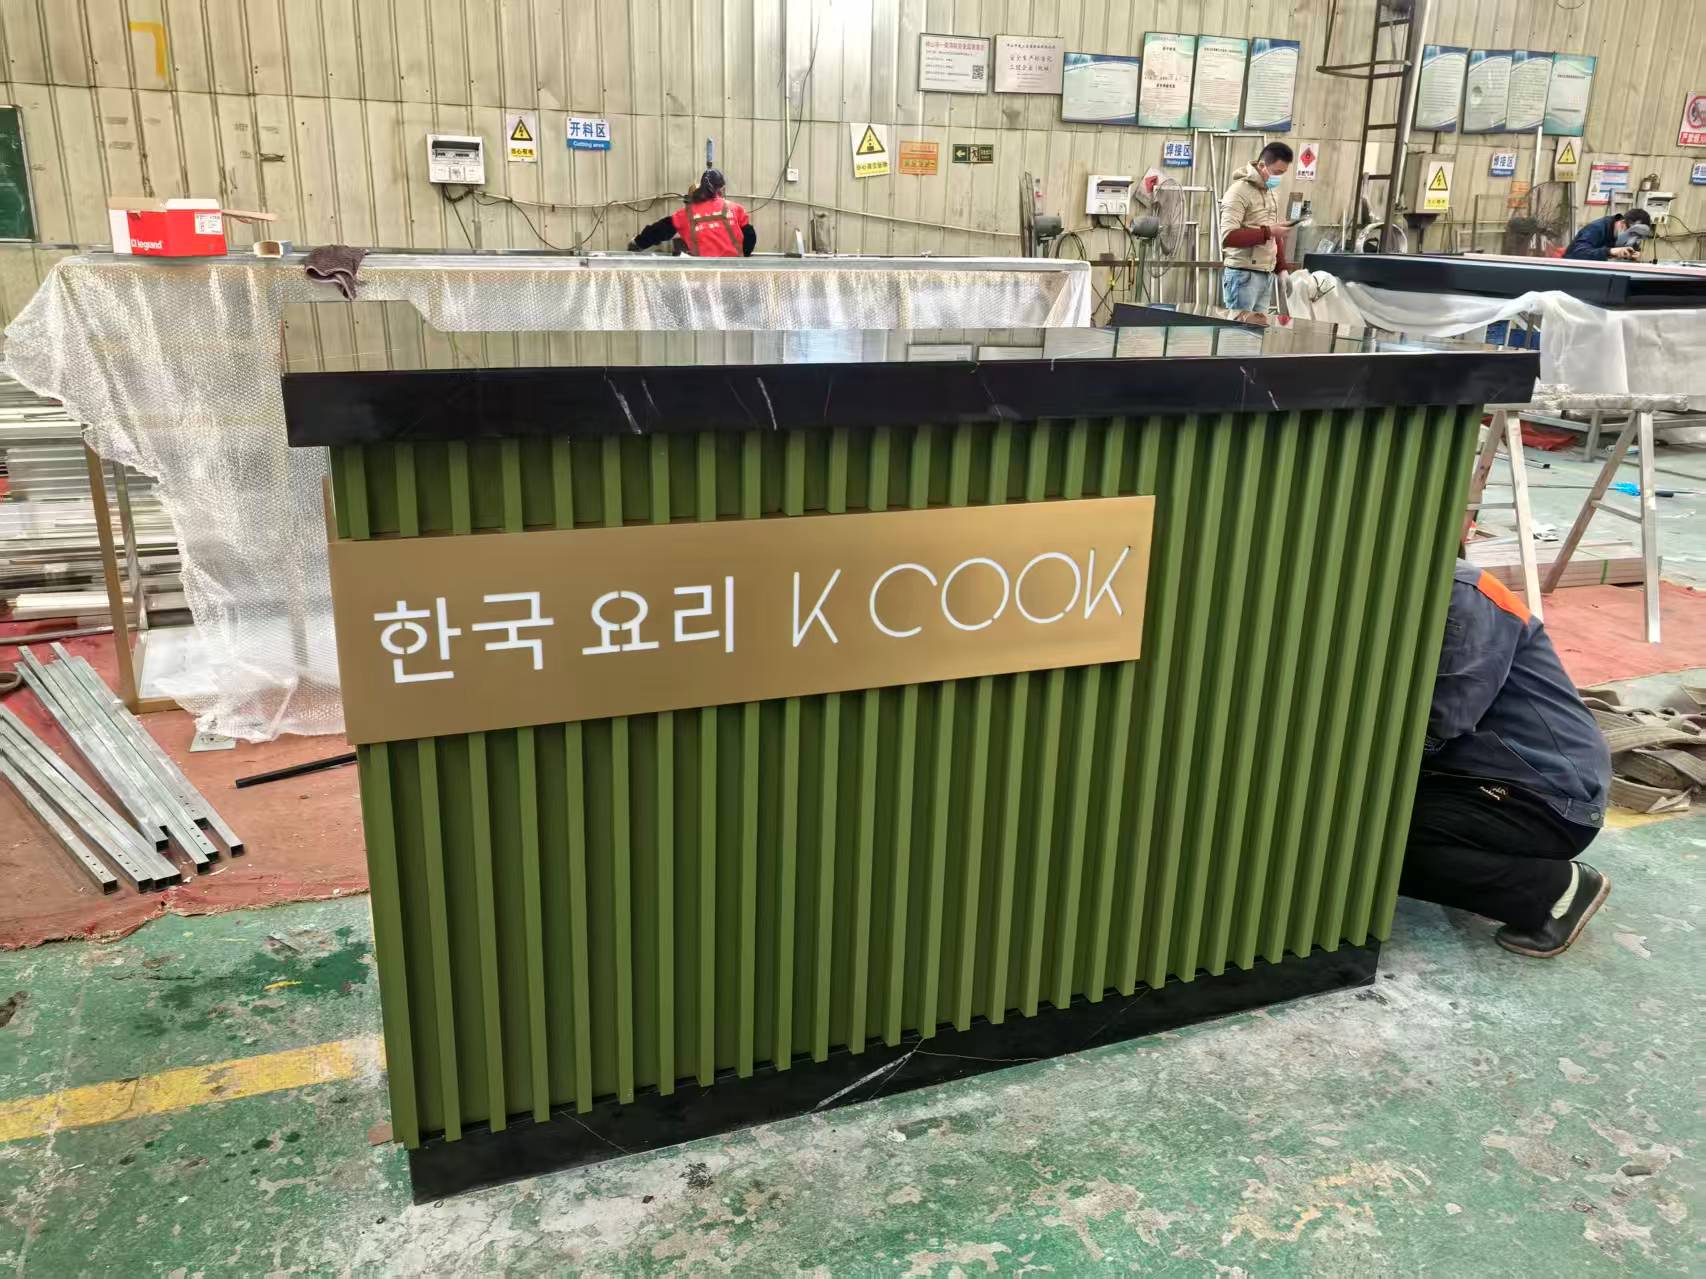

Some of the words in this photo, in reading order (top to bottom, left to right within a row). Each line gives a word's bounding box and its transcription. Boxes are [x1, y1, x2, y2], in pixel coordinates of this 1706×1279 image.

[570, 122, 606, 138] 开料区
[1167, 143, 1191, 157] 焊接区
[137, 239, 163, 251] legrand
[793, 568, 841, 648] K
[869, 546, 1130, 638] COOK
[374, 590, 555, 684] 한국
[583, 575, 736, 656] 요리
